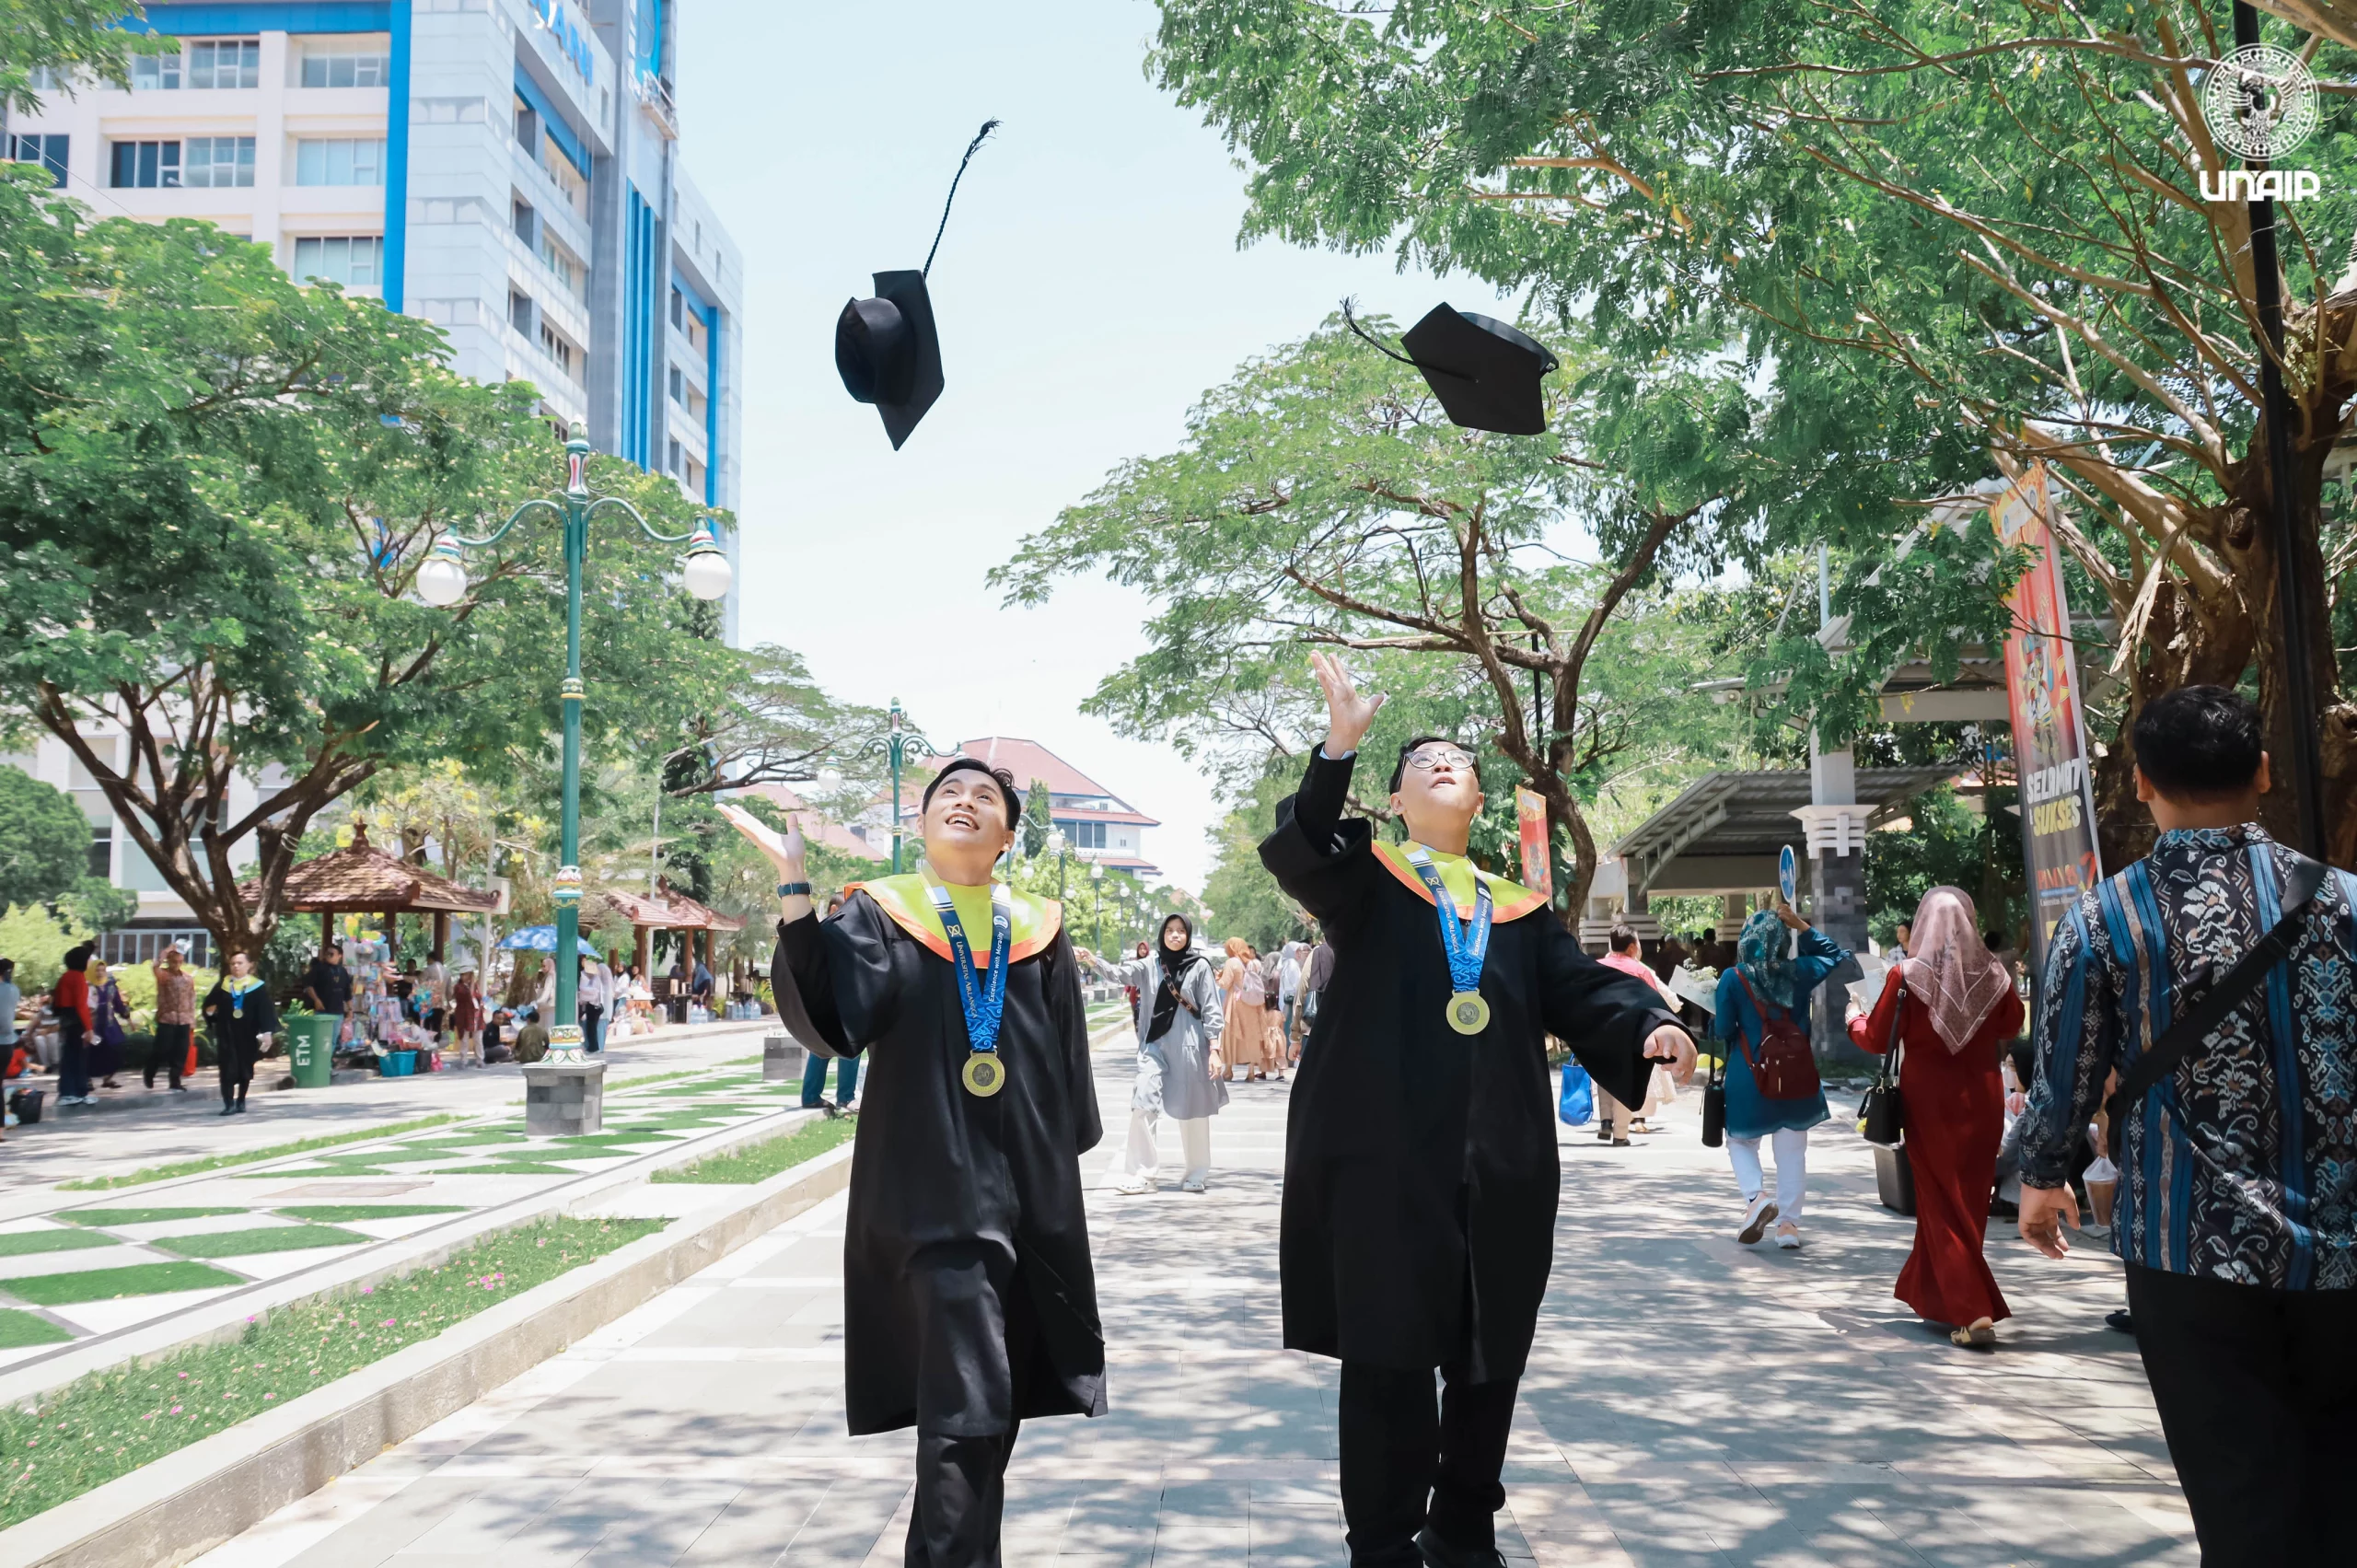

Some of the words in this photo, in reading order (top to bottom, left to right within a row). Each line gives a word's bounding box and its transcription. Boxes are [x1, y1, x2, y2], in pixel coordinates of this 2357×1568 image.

[2026, 758, 2082, 805] SELAMAT
[2033, 795, 2082, 837] SUKSES
[957, 941, 970, 980] UNIVERSITAS
[965, 981, 978, 1018] AIRLANGGA
[988, 970, 999, 1002] Excellence
[995, 932, 1004, 956] Morality
